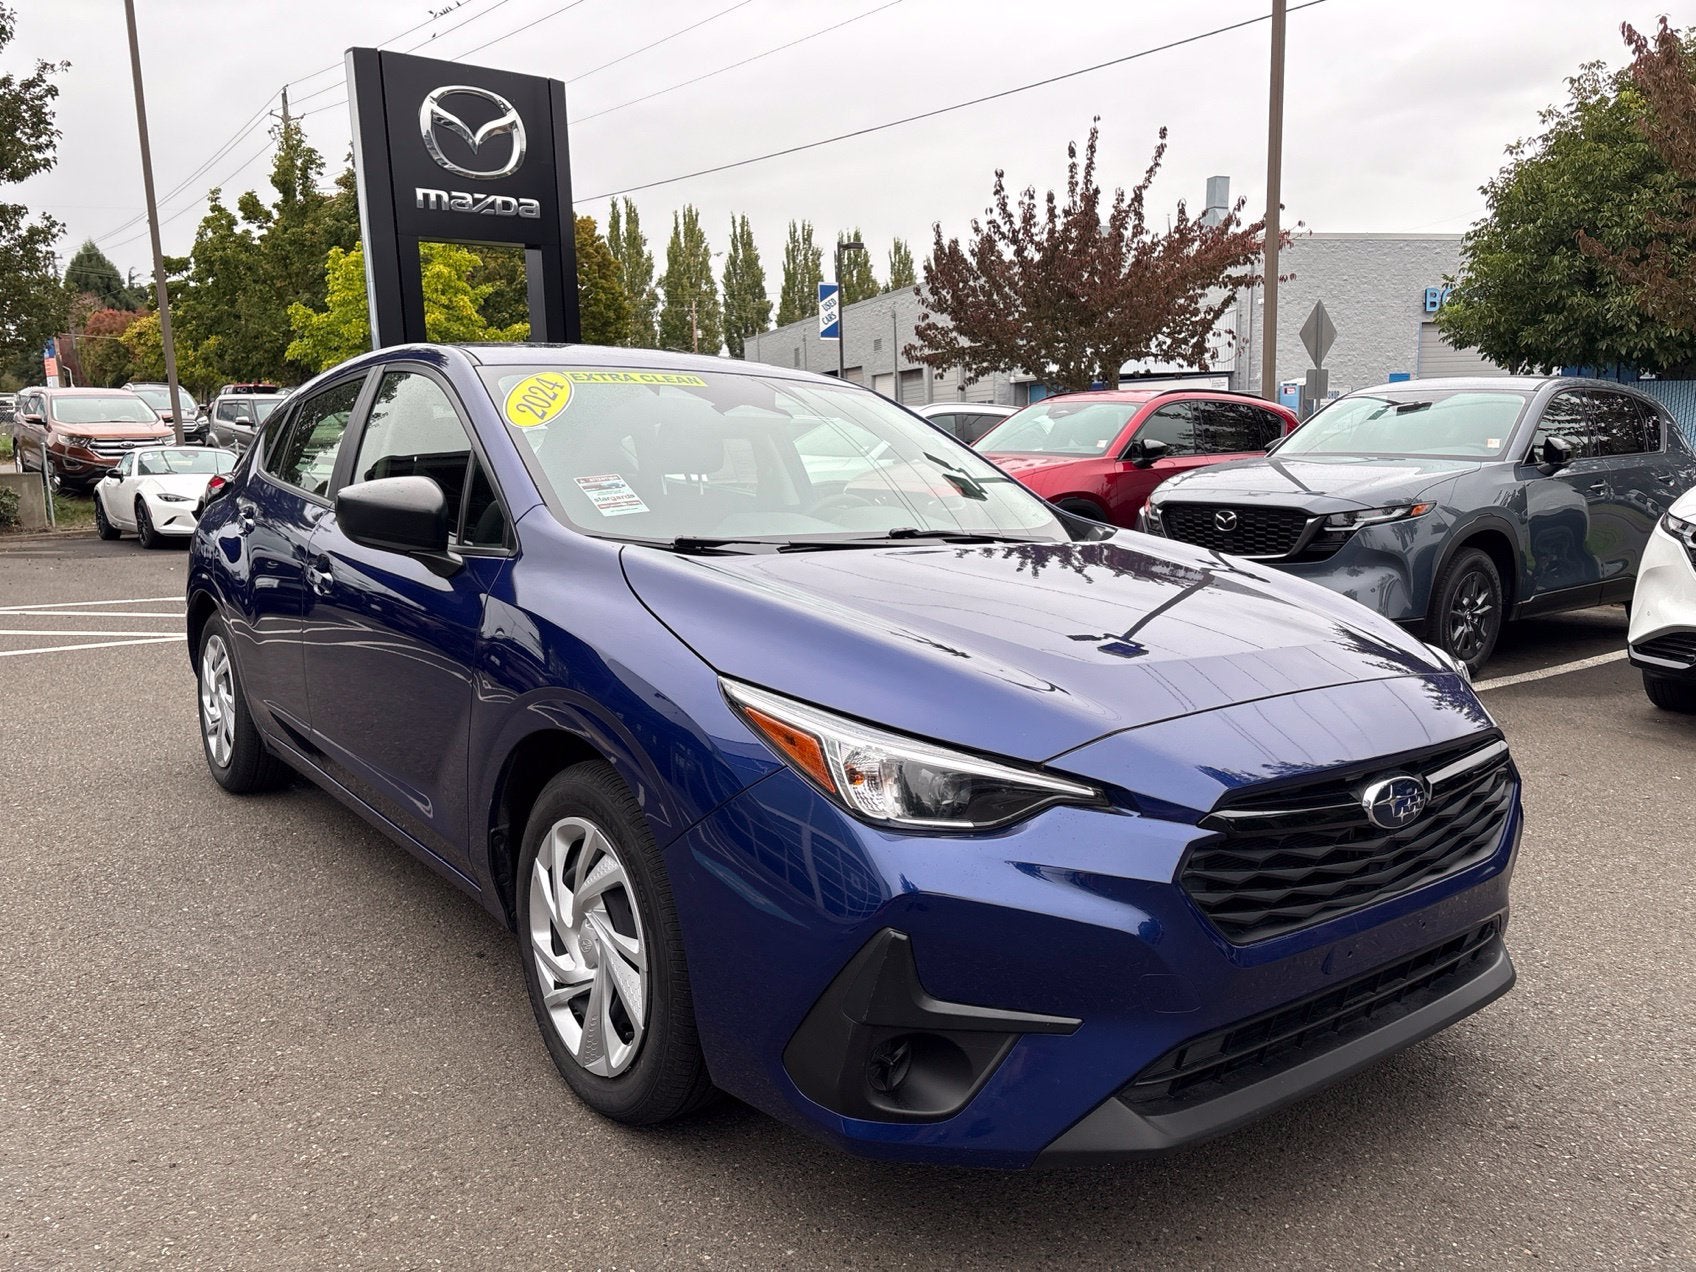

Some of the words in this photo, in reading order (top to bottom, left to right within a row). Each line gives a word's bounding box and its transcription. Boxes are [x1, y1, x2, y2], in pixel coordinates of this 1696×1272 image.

[415, 187, 540, 218] mazda
[821, 298, 837, 311] USED
[822, 311, 837, 325] CARS
[569, 372, 637, 382] EXTRA
[639, 374, 701, 385] CLEAN
[515, 377, 565, 420] 2024
